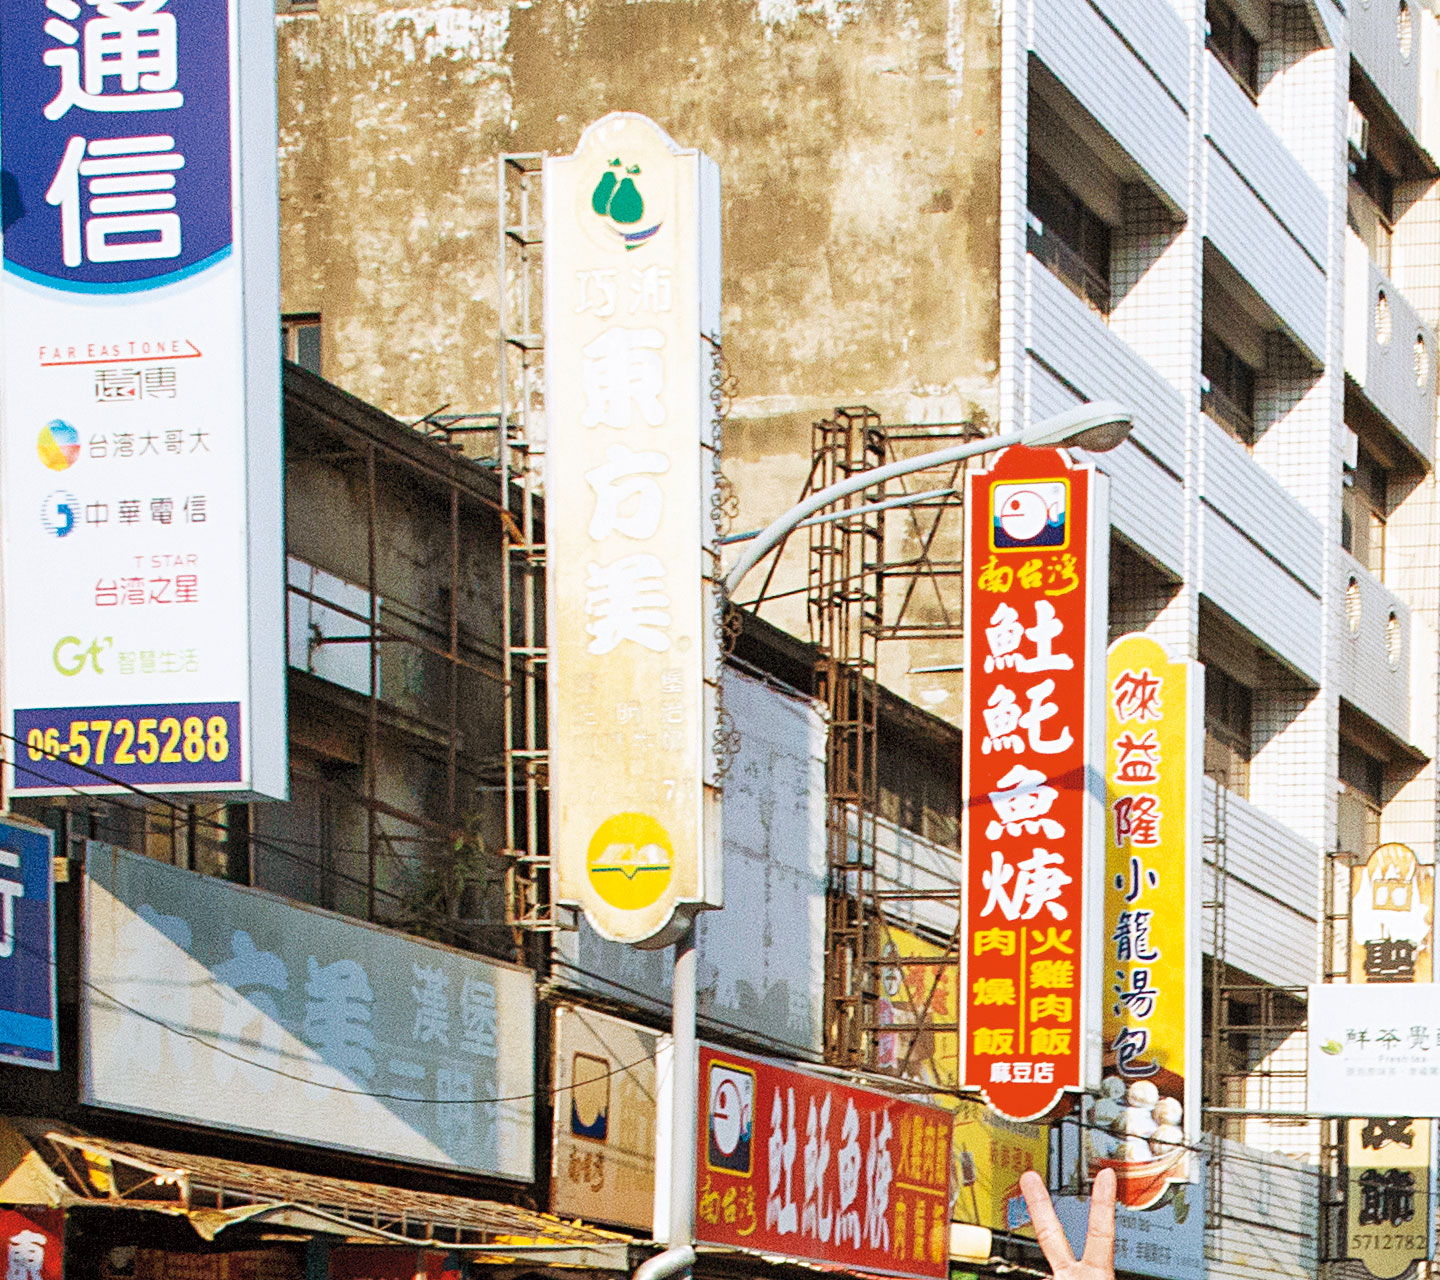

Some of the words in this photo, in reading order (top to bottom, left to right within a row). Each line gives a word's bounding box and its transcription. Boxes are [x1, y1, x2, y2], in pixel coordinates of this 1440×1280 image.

[43, 0, 185, 267] 通信
[86, 495, 207, 527] 中華電信
[582, 327, 670, 654] 東方美
[152, 554, 198, 568] STAR
[28, 716, 228, 766] 06-5725288
[972, 928, 1016, 1055] 肉燥飯
[1030, 927, 1073, 1055] 火雞肉飯
[990, 1061, 1054, 1084] 麻豆店
